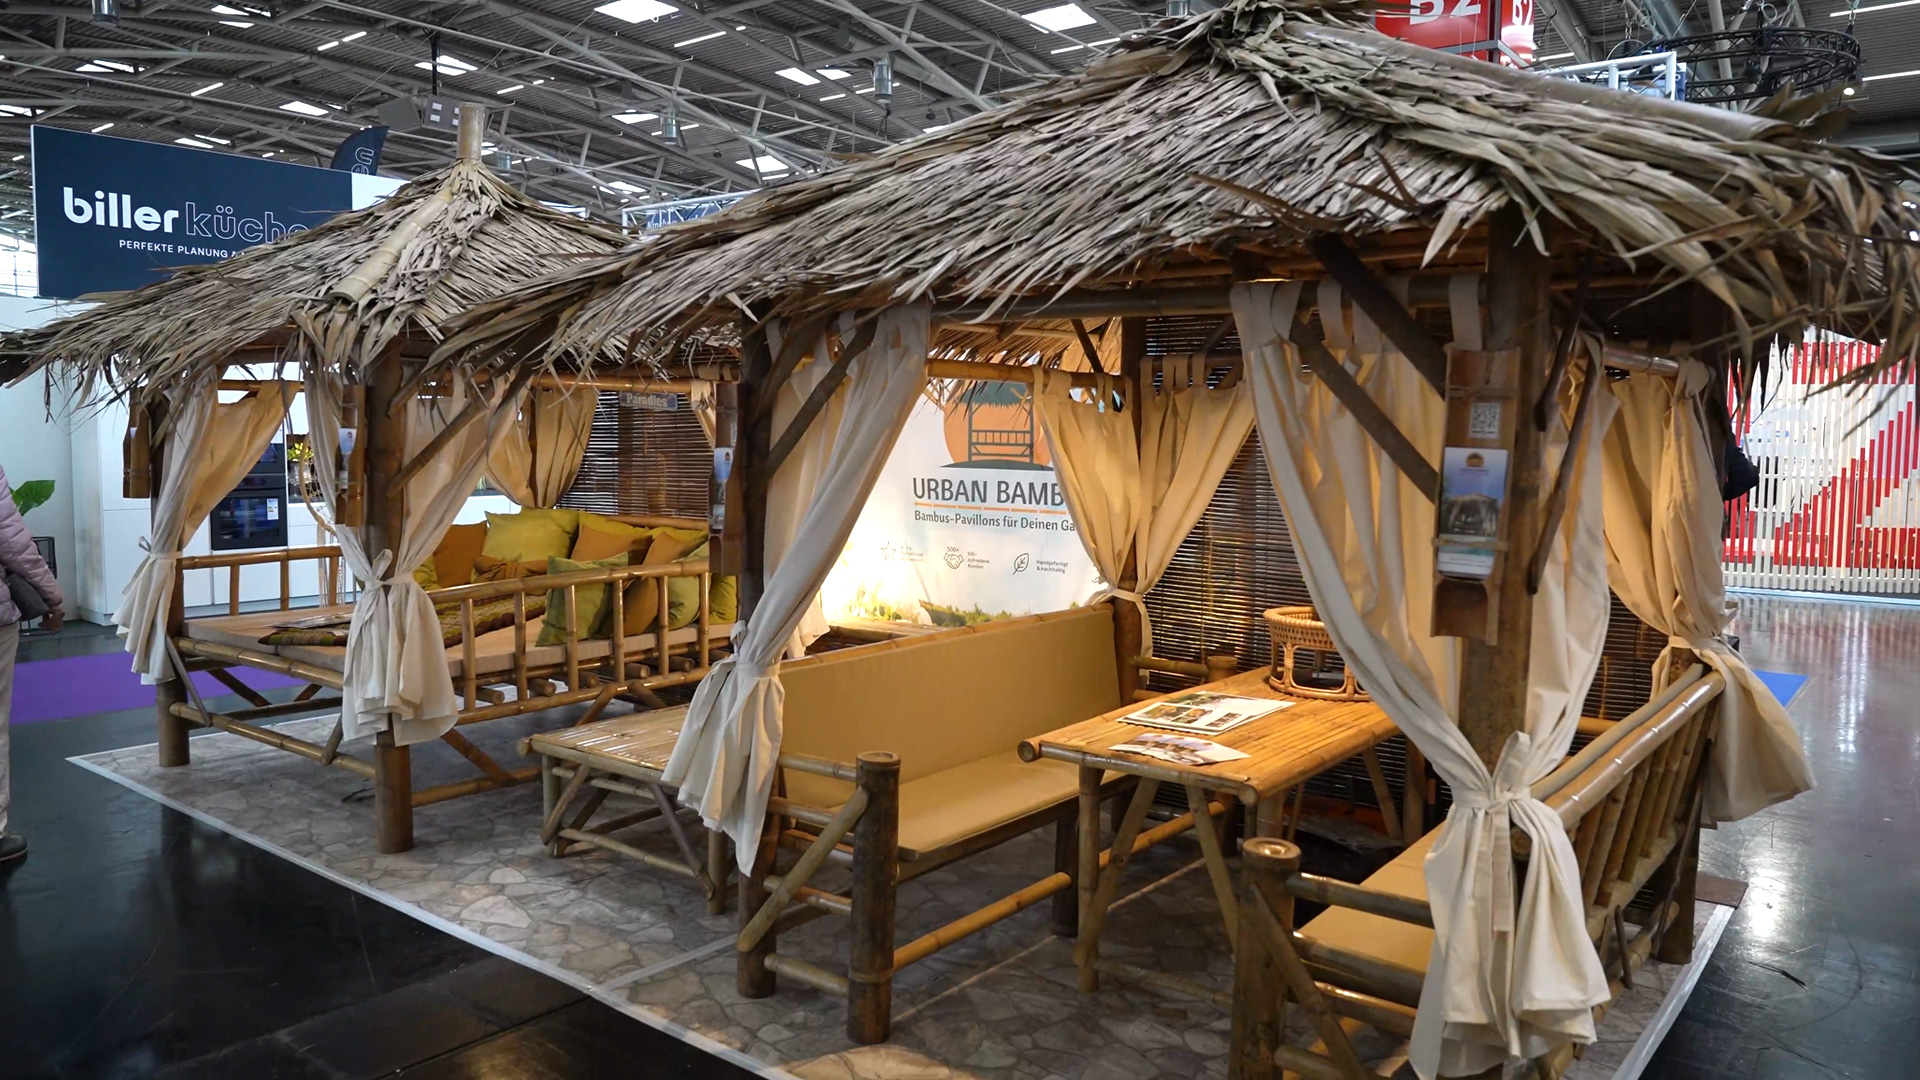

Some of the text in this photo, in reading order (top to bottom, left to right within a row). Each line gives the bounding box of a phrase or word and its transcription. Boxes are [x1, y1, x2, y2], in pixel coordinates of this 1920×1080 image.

[63, 186, 179, 233] biller
[119, 239, 174, 253] PERFEKTE
[177, 245, 228, 259] PLANUNG
[626, 392, 668, 408] Paradies
[913, 477, 1065, 507] URBAN BAMB
[914, 510, 1076, 532] Bambus-Pavillons für Deinen Ga
